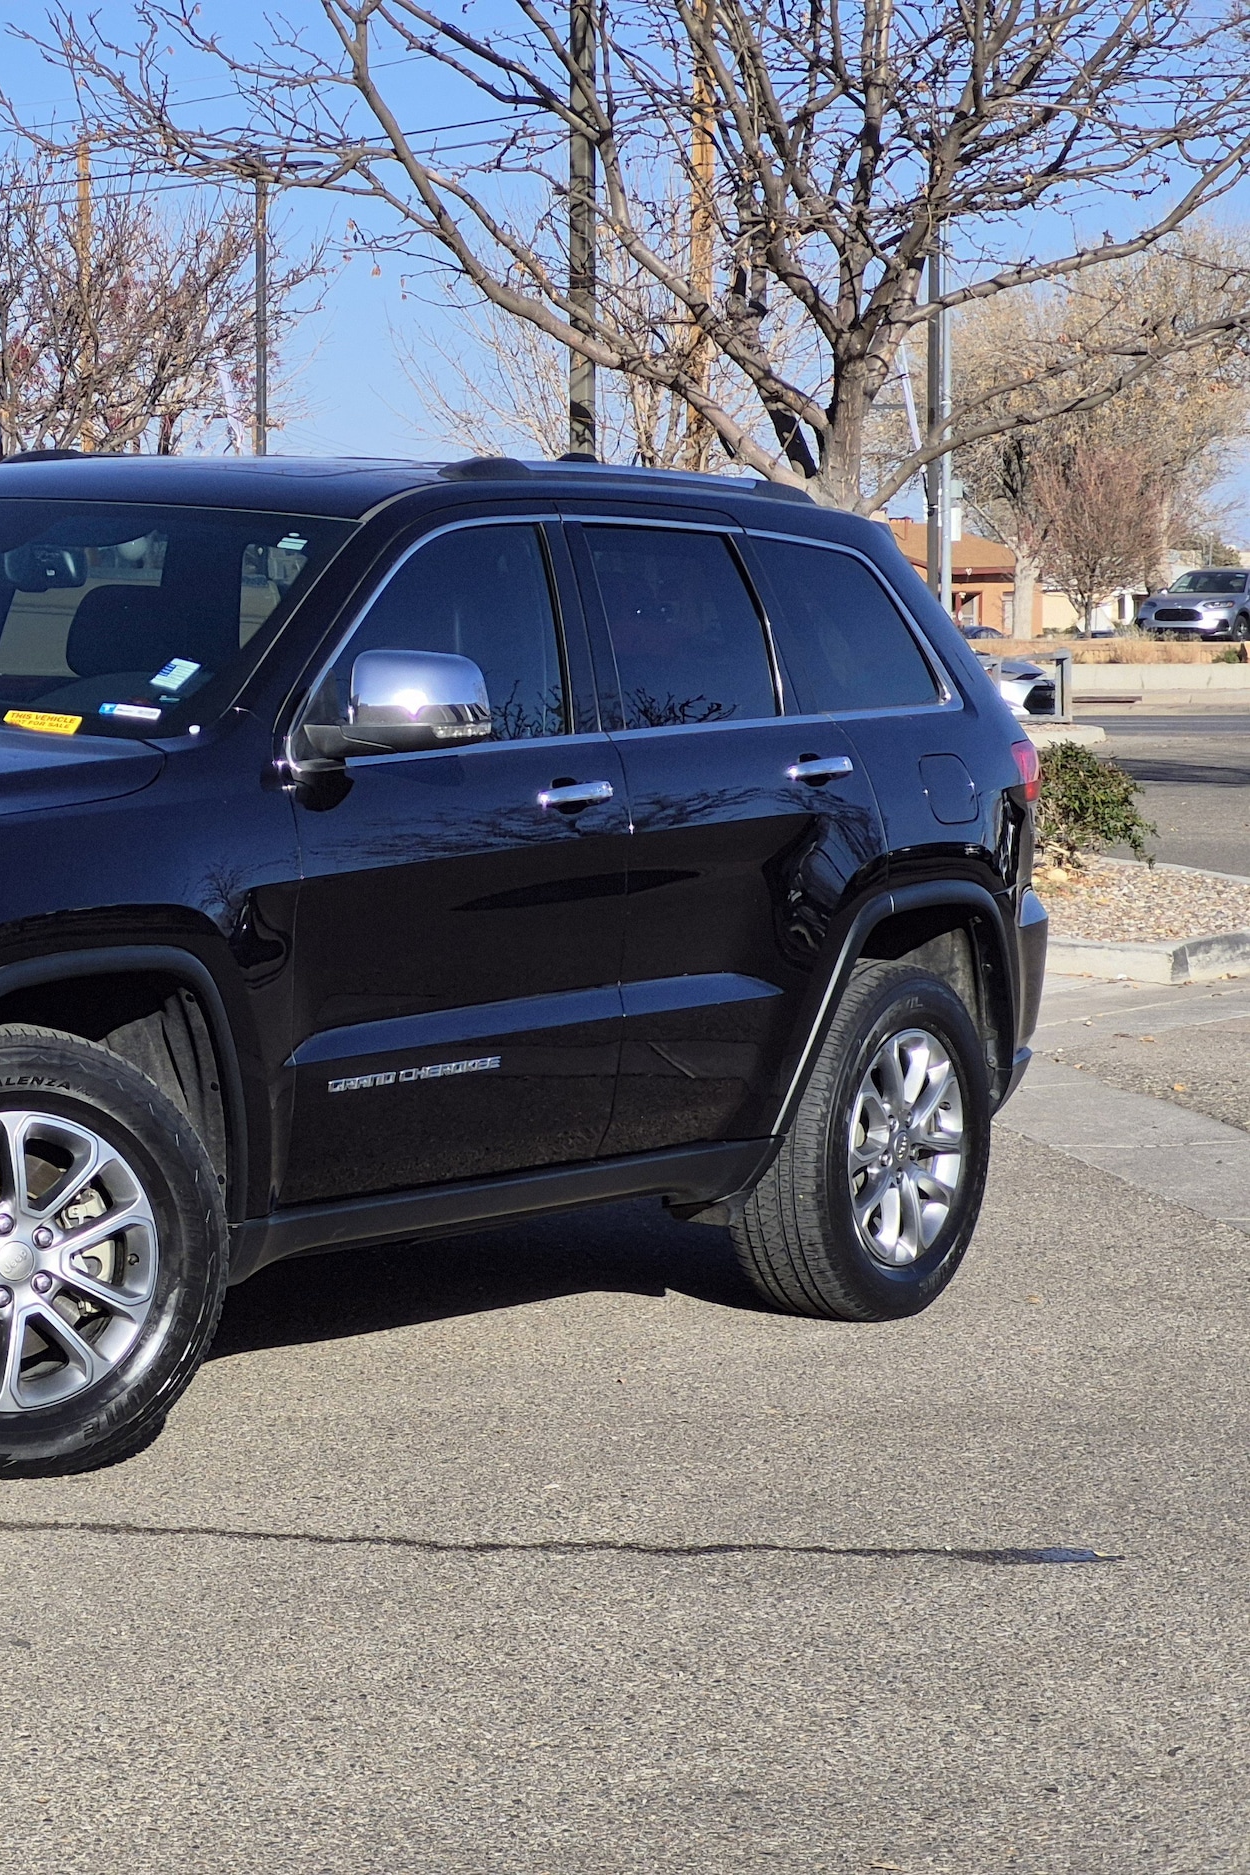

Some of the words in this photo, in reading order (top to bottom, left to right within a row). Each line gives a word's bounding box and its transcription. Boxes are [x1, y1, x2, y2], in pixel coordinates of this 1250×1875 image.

[11, 712, 32, 720] THIS
[35, 714, 77, 724] VEHICLE
[327, 1071, 397, 1093] GRAND
[399, 1056, 502, 1083] CHEROKEE
[3, 1250, 27, 1274] Jeep
